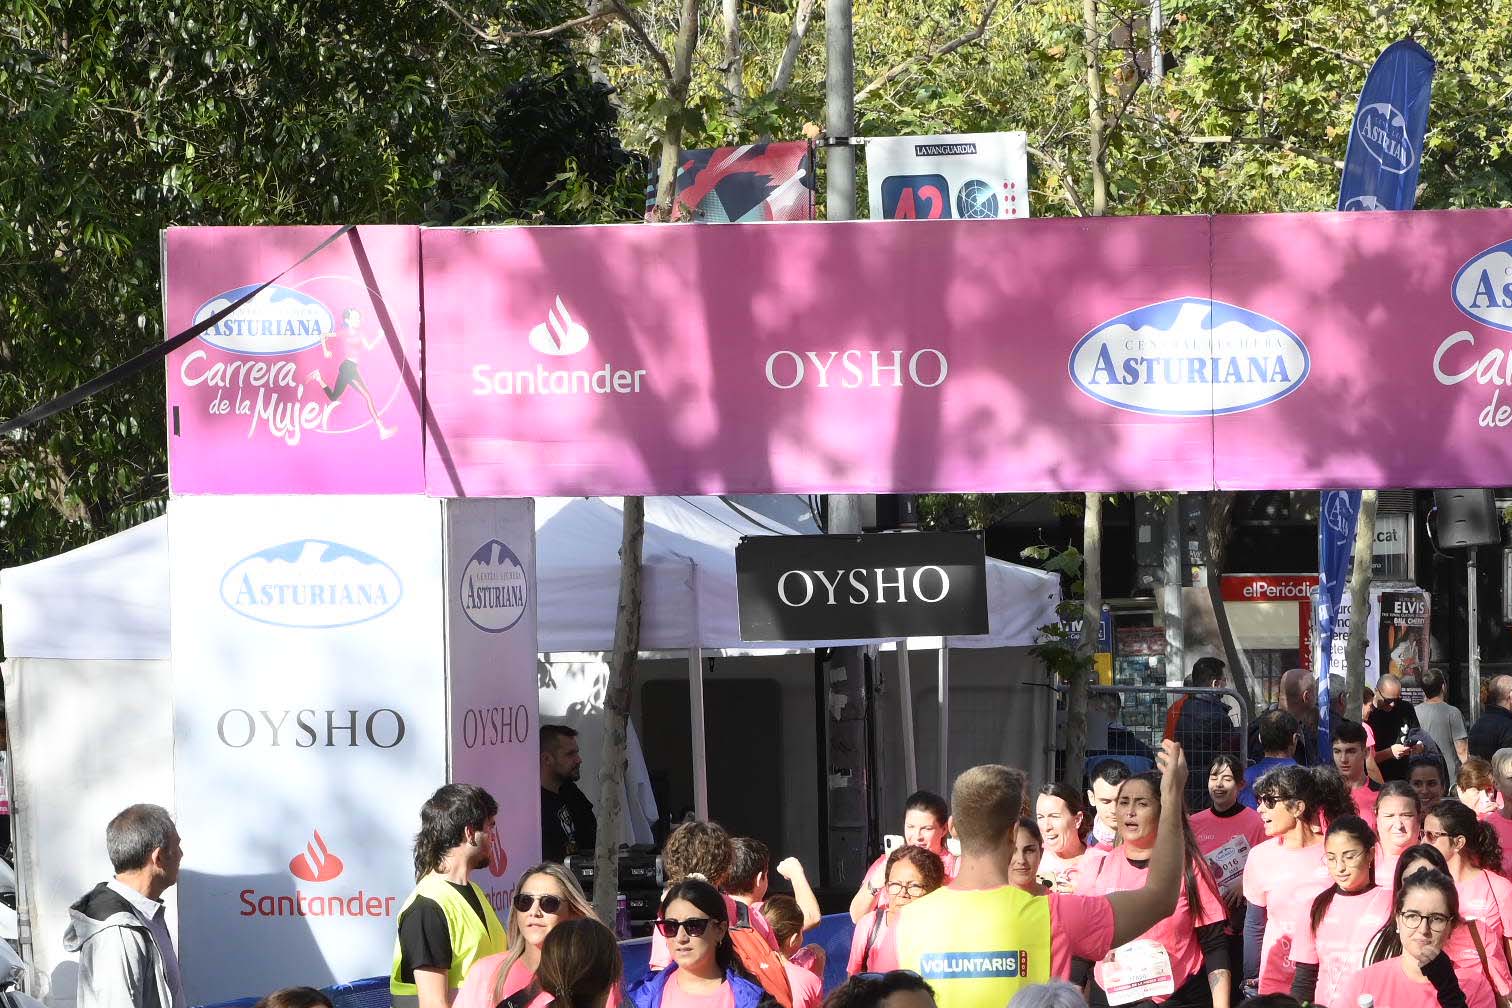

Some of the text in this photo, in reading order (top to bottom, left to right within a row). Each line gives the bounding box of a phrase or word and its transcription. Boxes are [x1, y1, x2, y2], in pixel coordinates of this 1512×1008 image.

[203, 310, 323, 337] ASTURIANA
[180, 351, 297, 388] Carrera
[472, 363, 647, 396] Santander
[765, 348, 949, 390] OYSHO
[1089, 341, 1292, 386] ASTURIANA
[208, 384, 341, 447] de la Mujer
[235, 571, 388, 607] ASTURIANA
[465, 573, 525, 611] ASTURIANA
[777, 565, 950, 607] OYSHO
[1395, 601, 1425, 614] ELVIS
[217, 708, 406, 749] OYSHO
[463, 703, 530, 749] OYSHO
[240, 888, 396, 917] Santander
[922, 957, 1016, 973] VOLUNTARIS
